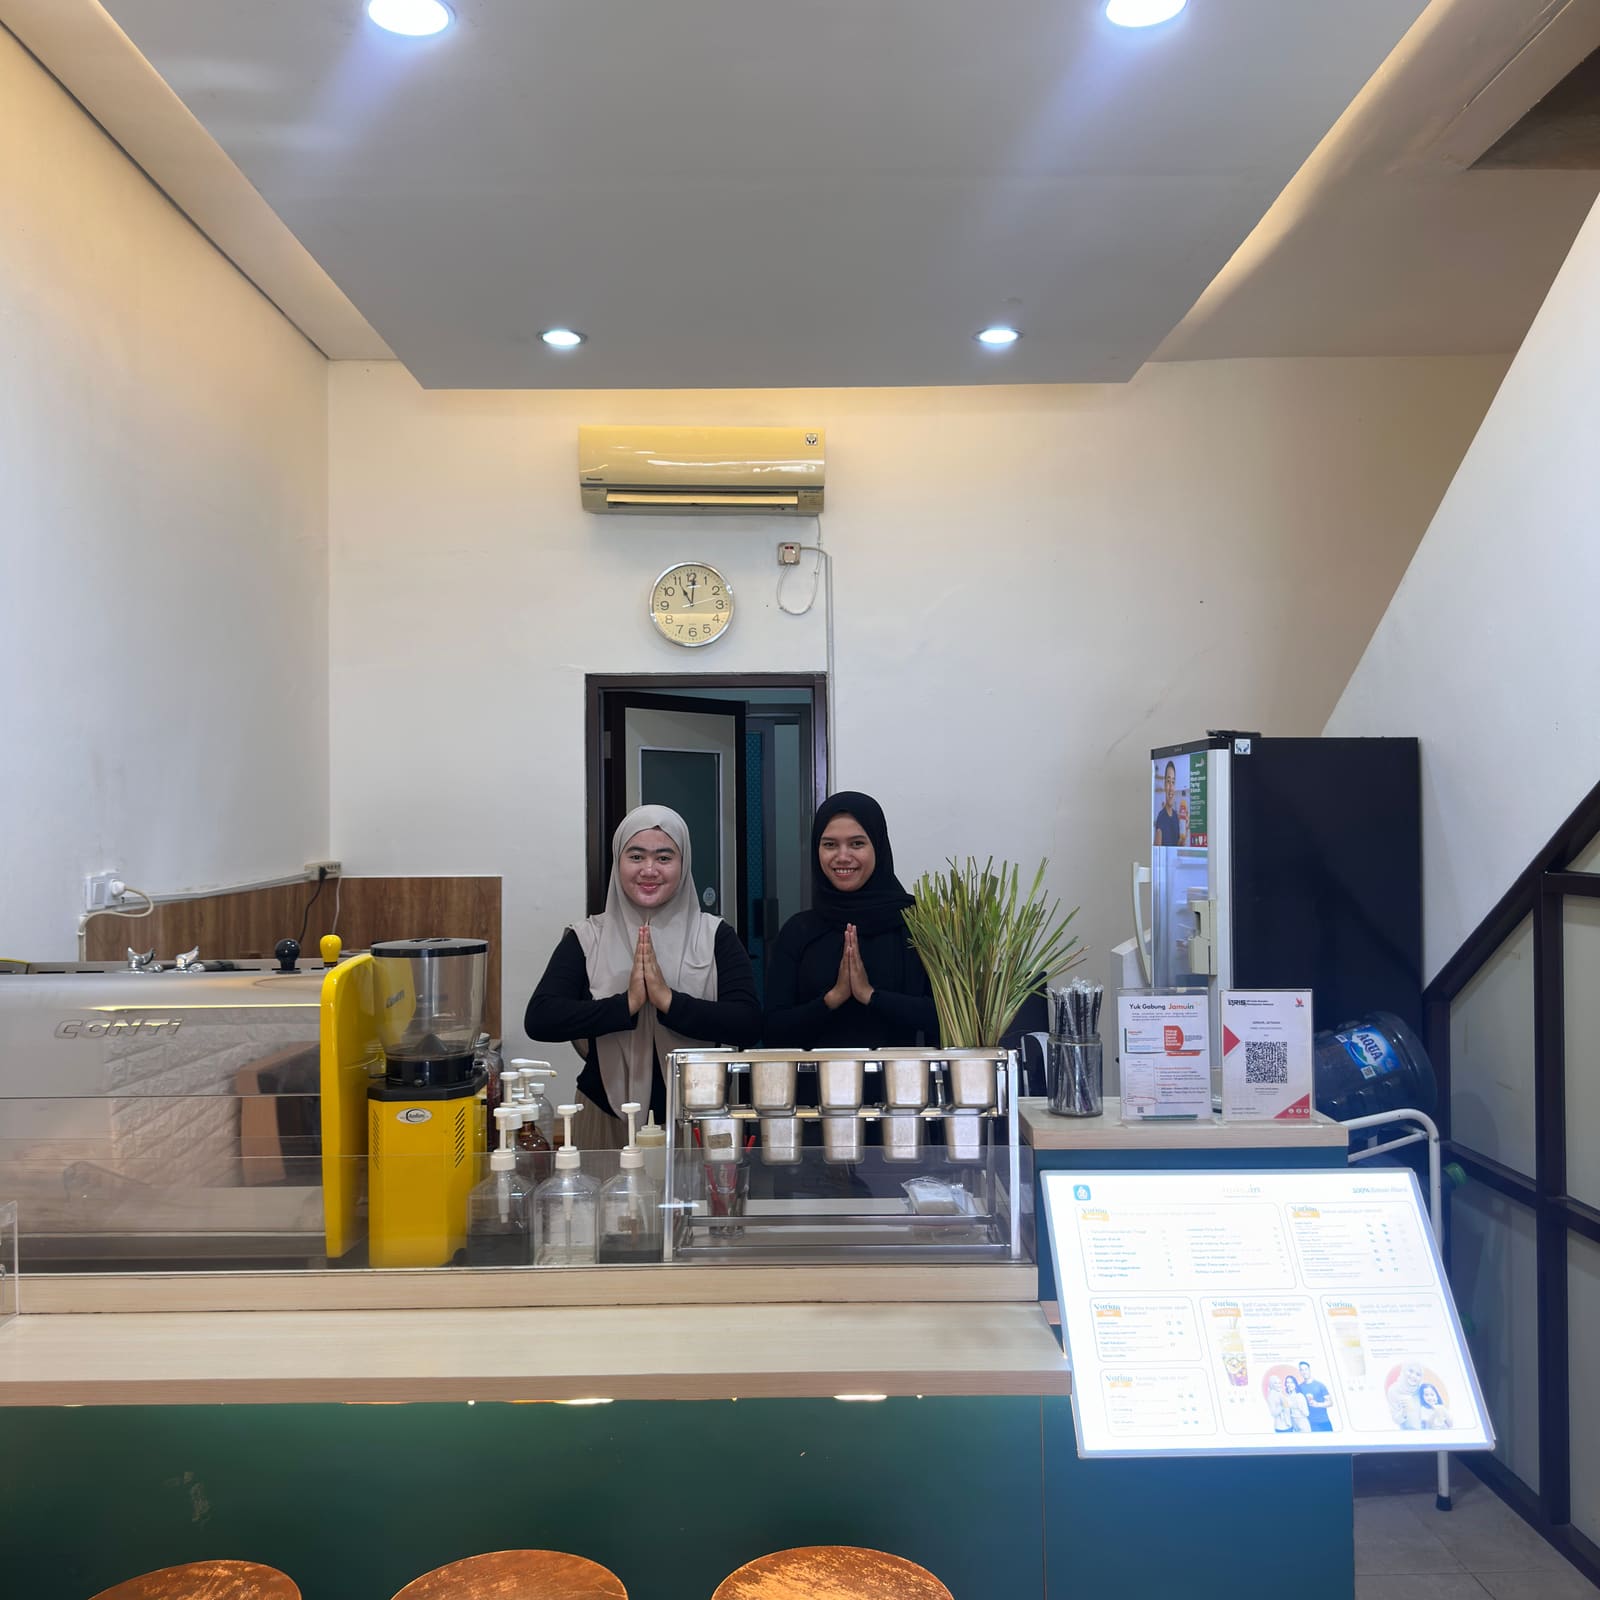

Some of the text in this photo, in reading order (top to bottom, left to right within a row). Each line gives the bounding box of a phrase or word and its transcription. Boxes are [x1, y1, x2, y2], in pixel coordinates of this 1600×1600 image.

[673, 575, 682, 586] 11
[686, 572, 697, 583] 12
[703, 575, 708, 585] 1
[663, 586, 675, 597] 10
[711, 585, 721, 596] 2
[660, 600, 670, 611] 9
[715, 599, 724, 610] 3
[665, 614, 674, 625] 8
[712, 614, 720, 624] 4
[676, 624, 684, 635] 7
[688, 627, 698, 638] 6
[702, 623, 711, 634] 5
[1142, 1003, 1166, 1011] Gabung
[1168, 1002, 1195, 1010] Jamuin
[54, 1018, 184, 1040] CONTI
[1356, 1033, 1384, 1061] AQUA
